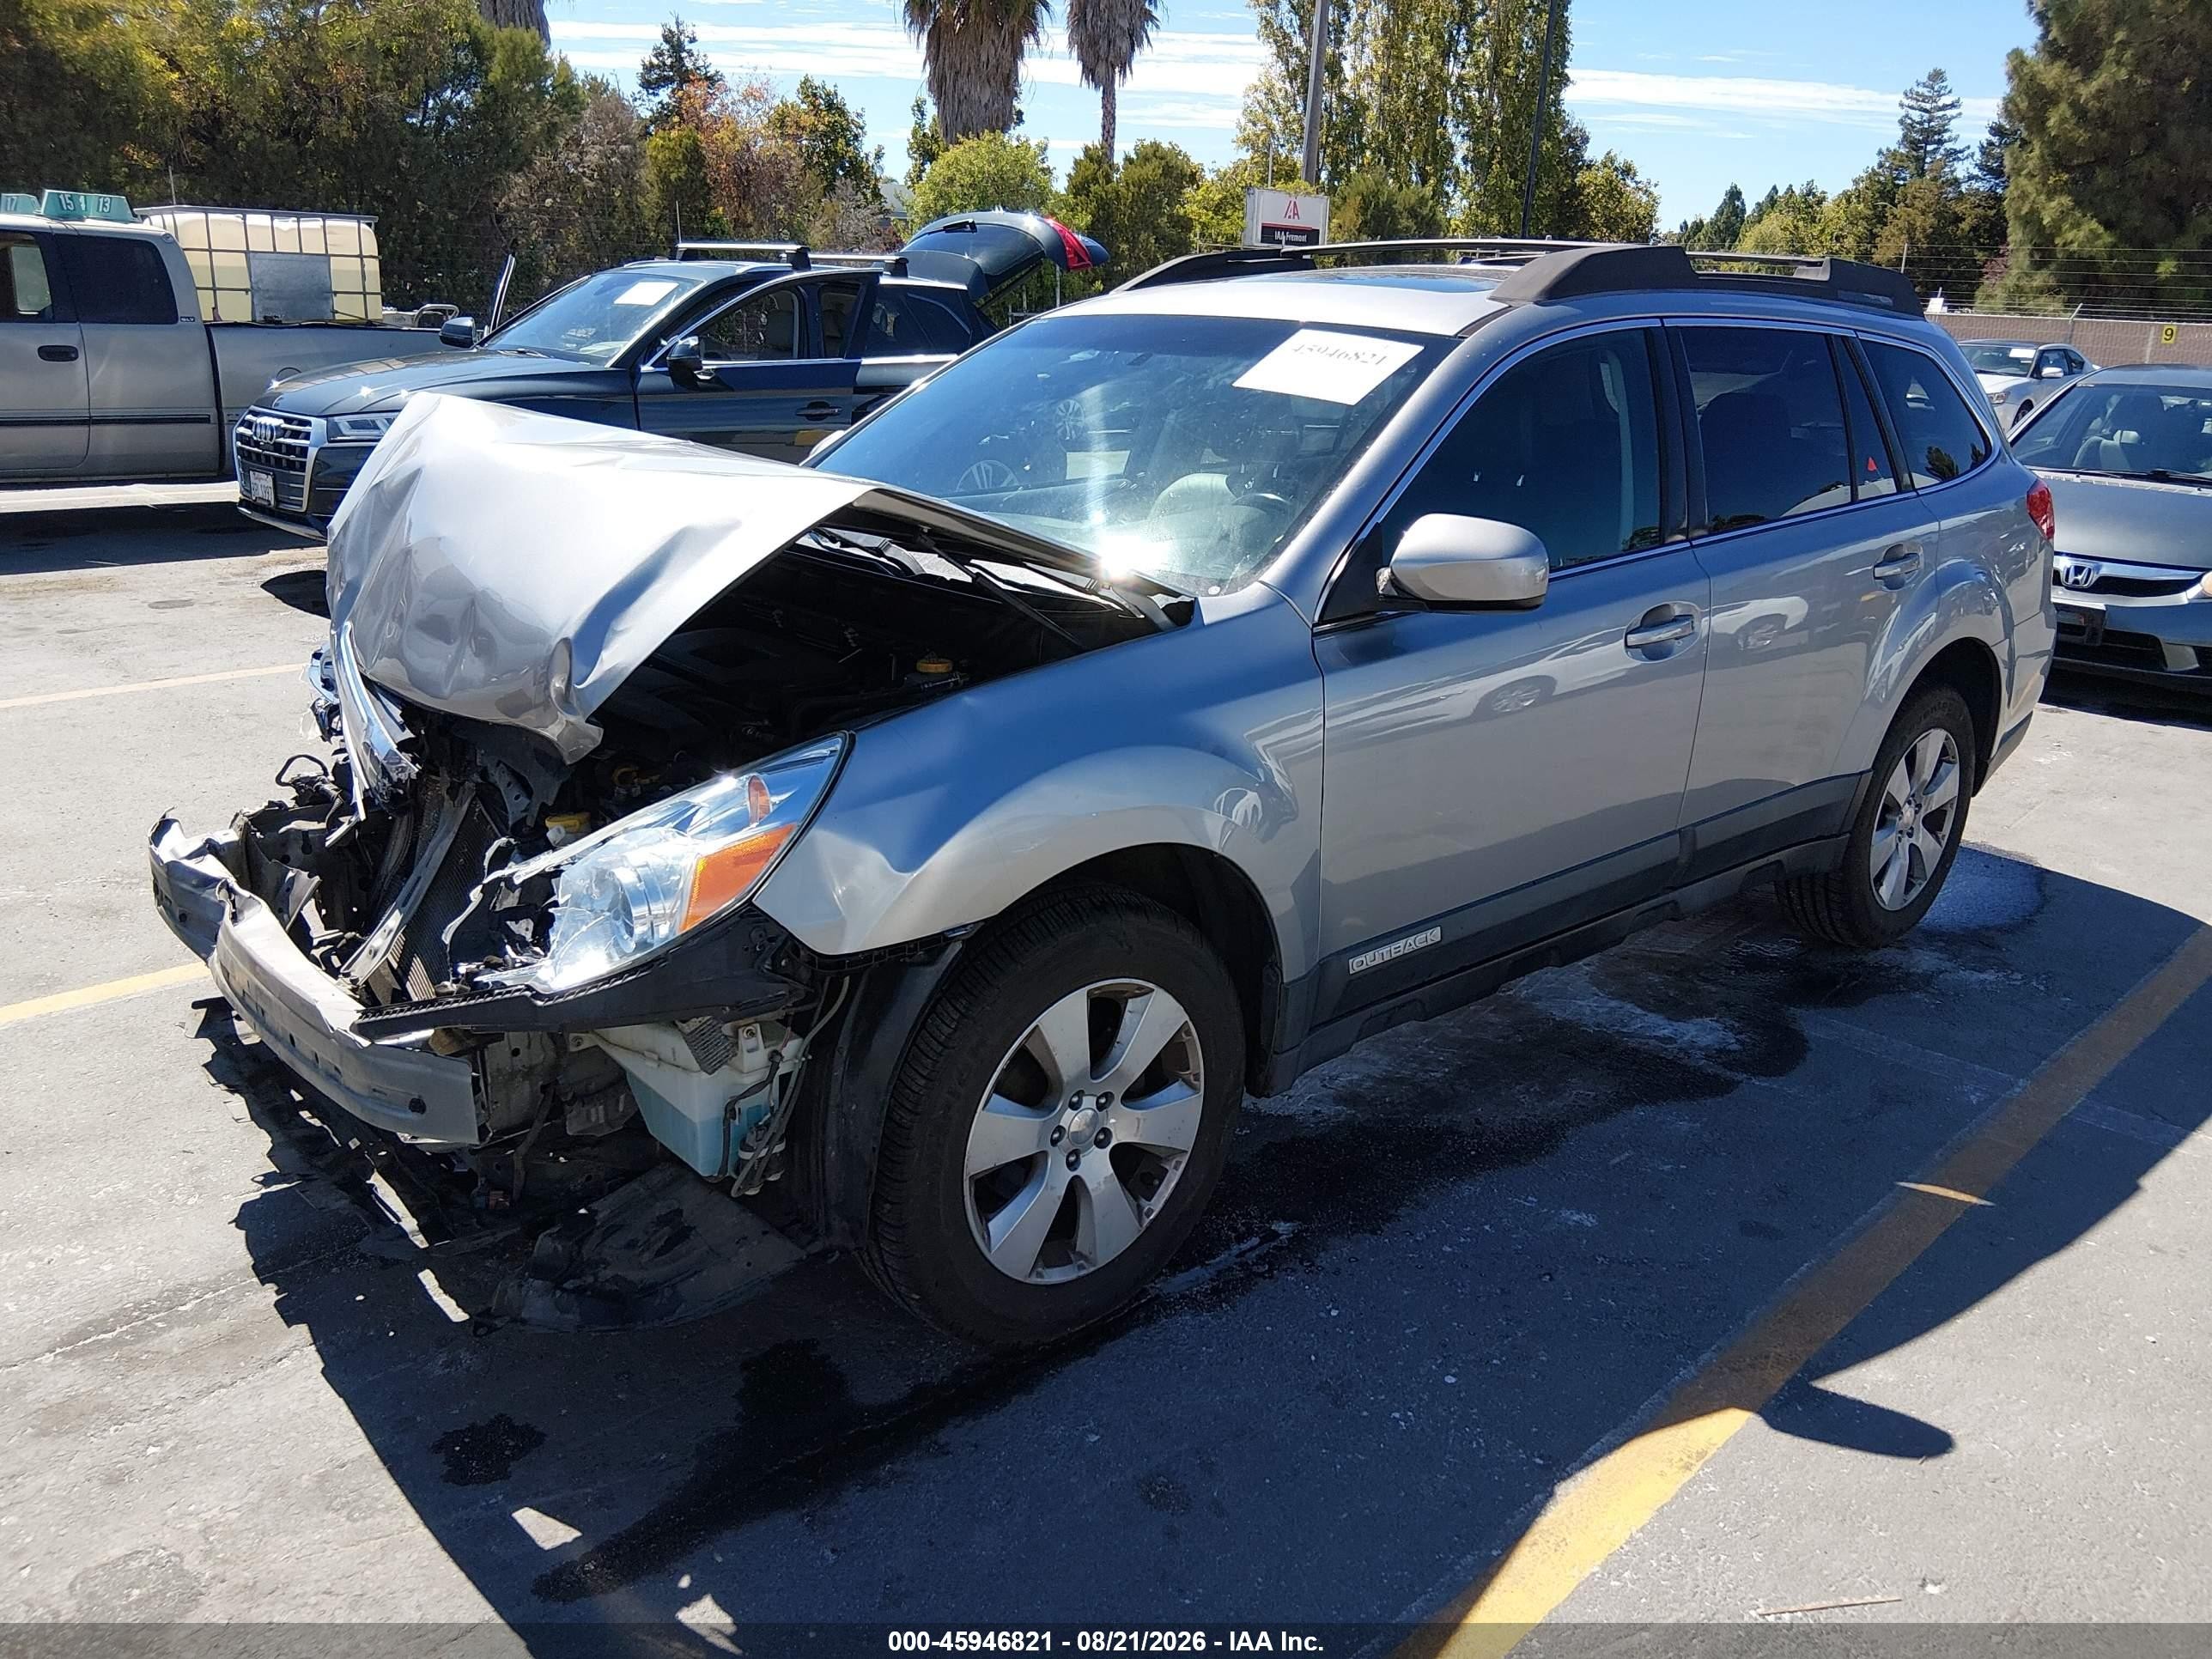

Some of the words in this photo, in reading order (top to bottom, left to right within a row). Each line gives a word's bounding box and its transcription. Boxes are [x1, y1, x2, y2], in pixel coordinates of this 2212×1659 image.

[6, 196, 17, 211] 17
[58, 194, 75, 210] 15
[98, 197, 111, 212] 13
[1286, 231, 1307, 242] Fremont
[2164, 328, 2173, 341] 9
[1351, 928, 1437, 971] OUTBACK
